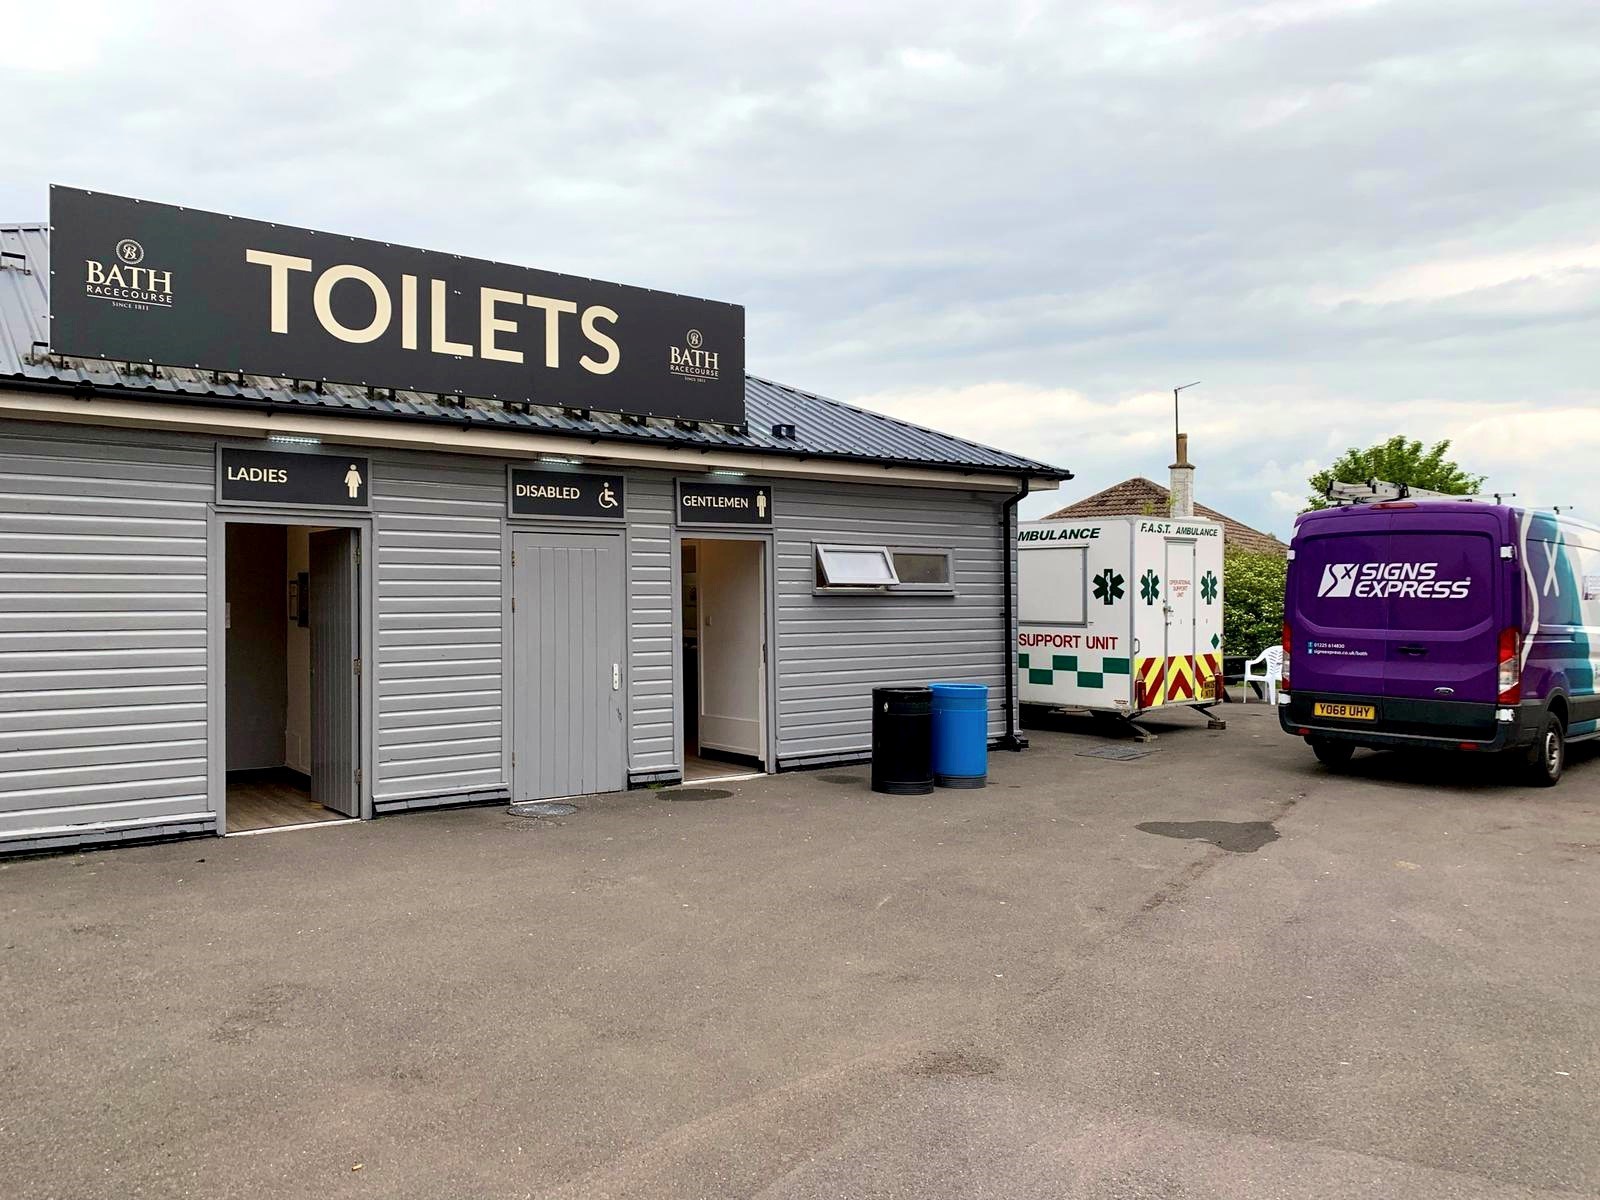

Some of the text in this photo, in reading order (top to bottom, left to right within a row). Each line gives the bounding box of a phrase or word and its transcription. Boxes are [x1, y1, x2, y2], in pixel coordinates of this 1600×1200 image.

[86, 260, 173, 294] BATH
[86, 285, 172, 303] RACECOURSE
[112, 301, 132, 309] SINCE
[246, 249, 620, 375] TOILETS
[670, 346, 719, 370] BATH
[670, 364, 719, 377] RACECOURSE
[228, 466, 288, 483] LADIES
[515, 484, 580, 500] DISABLED
[682, 495, 749, 509] GENTLEMEN
[1140, 523, 1219, 537] F.A.S.T. AMBULANCE
[1360, 563, 1438, 580] SIGNS
[1355, 581, 1471, 599] EXPRESS
[1018, 633, 1118, 650] SUPPORT UNIT
[1320, 704, 1370, 717] YO68 UHY
